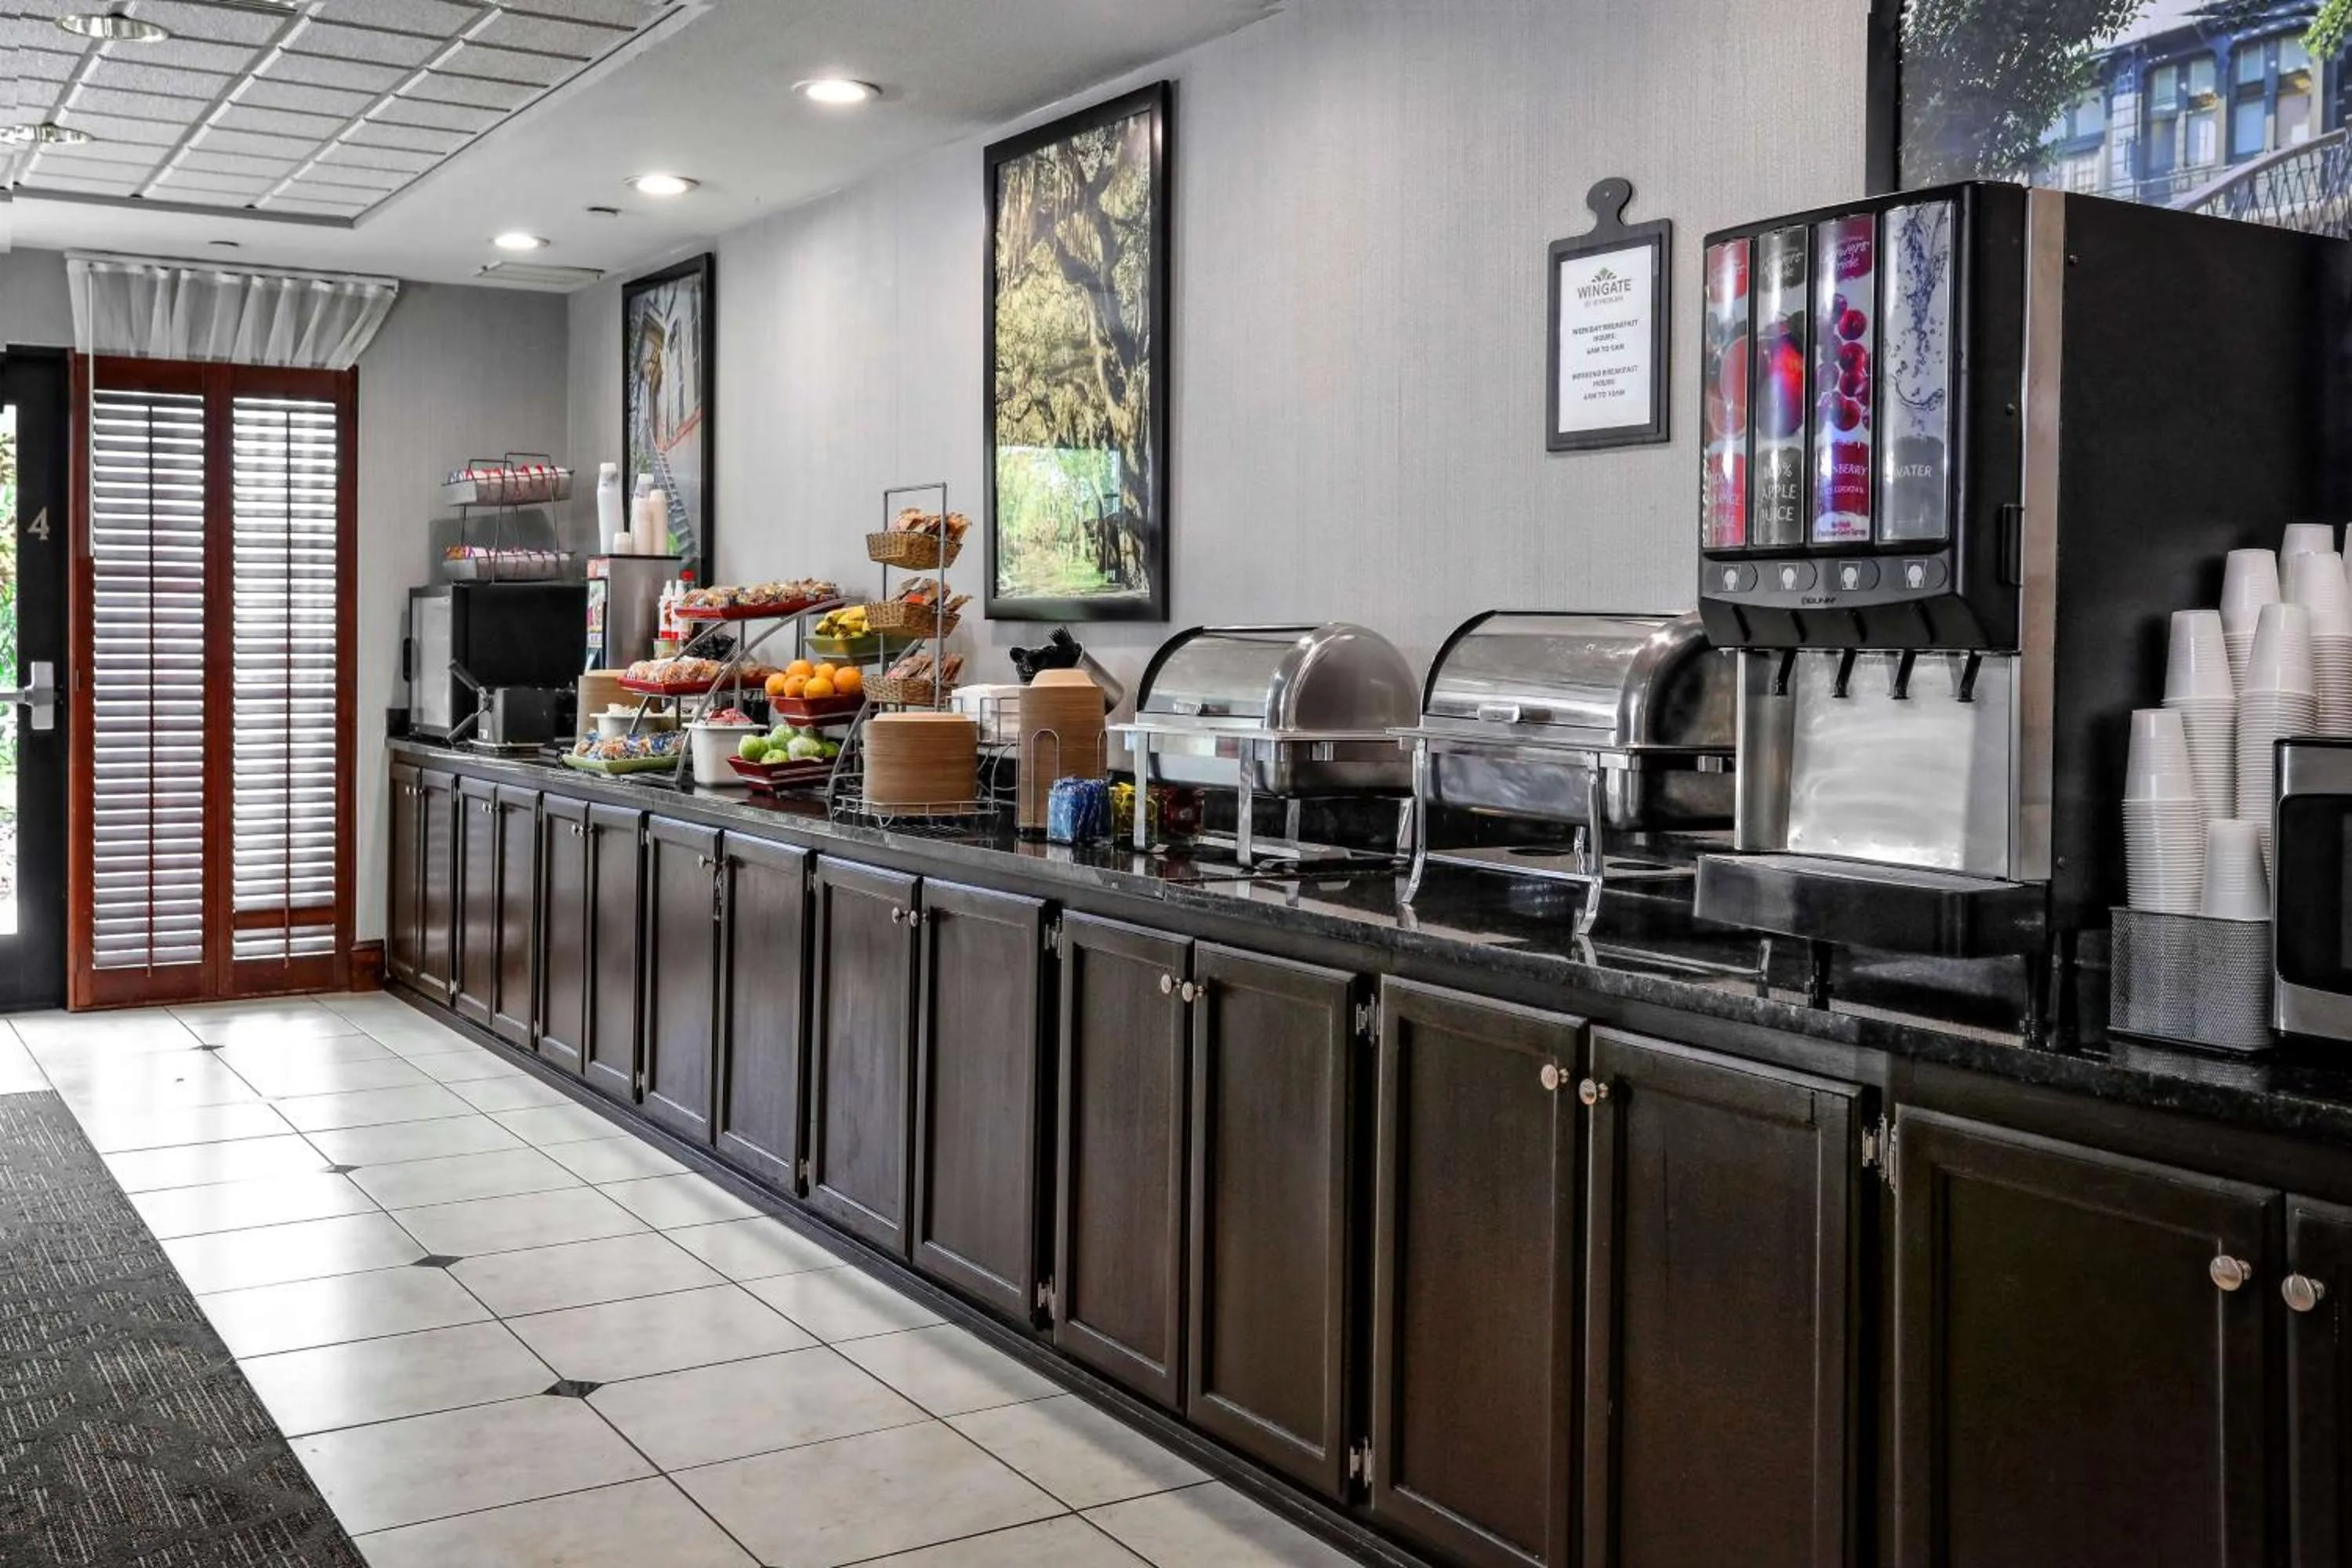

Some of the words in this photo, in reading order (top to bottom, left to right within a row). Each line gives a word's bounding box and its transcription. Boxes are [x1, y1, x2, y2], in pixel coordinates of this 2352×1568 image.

[1577, 278, 1632, 299] WINGATE
[1762, 484, 1797, 499] APPLE
[27, 506, 50, 540] 4
